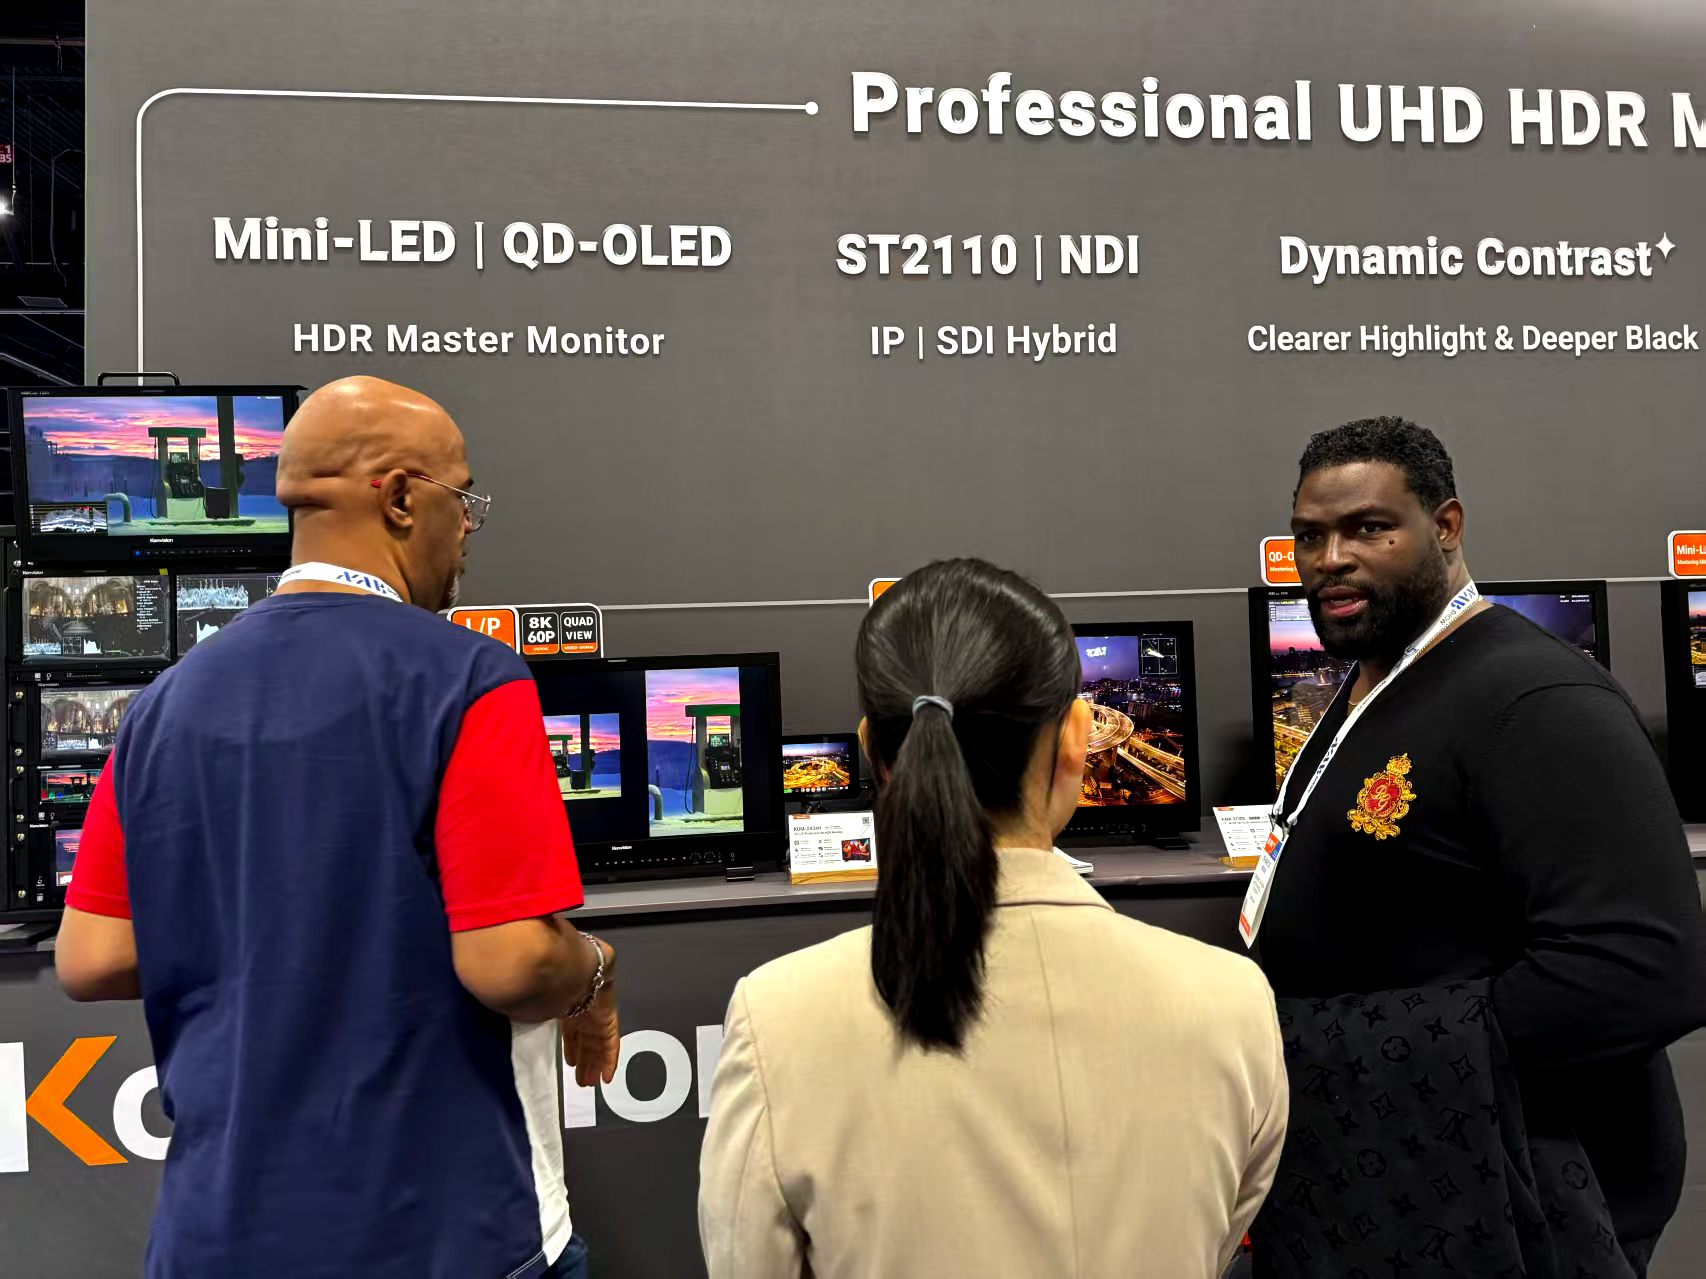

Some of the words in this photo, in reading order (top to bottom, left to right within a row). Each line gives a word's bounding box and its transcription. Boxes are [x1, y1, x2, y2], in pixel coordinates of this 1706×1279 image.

[851, 71, 1311, 141] Professional
[1338, 83, 1483, 143] UHD
[1508, 88, 1648, 147] HDR
[213, 216, 456, 262] Mini-LED
[503, 221, 732, 270] QD-OLED
[835, 233, 1017, 275] ST2110
[1059, 234, 1139, 274] NDI
[1279, 235, 1464, 285] Dynamic
[1476, 238, 1653, 277] Contrast
[294, 323, 373, 353] HDR
[387, 324, 514, 354] Master
[527, 325, 665, 356] Monitor
[871, 326, 905, 355] IP
[937, 325, 994, 355] SDI
[1007, 323, 1117, 362] Hybrid
[1247, 324, 1352, 351] Clearer
[1360, 324, 1487, 357] Highlight
[1494, 325, 1515, 351] &
[1522, 325, 1618, 357] Deeper
[1625, 324, 1700, 350] Black
[527, 631, 555, 643] 60P
[529, 616, 552, 629] 8K
[563, 616, 594, 627] QUAD
[565, 630, 592, 640] VIEW
